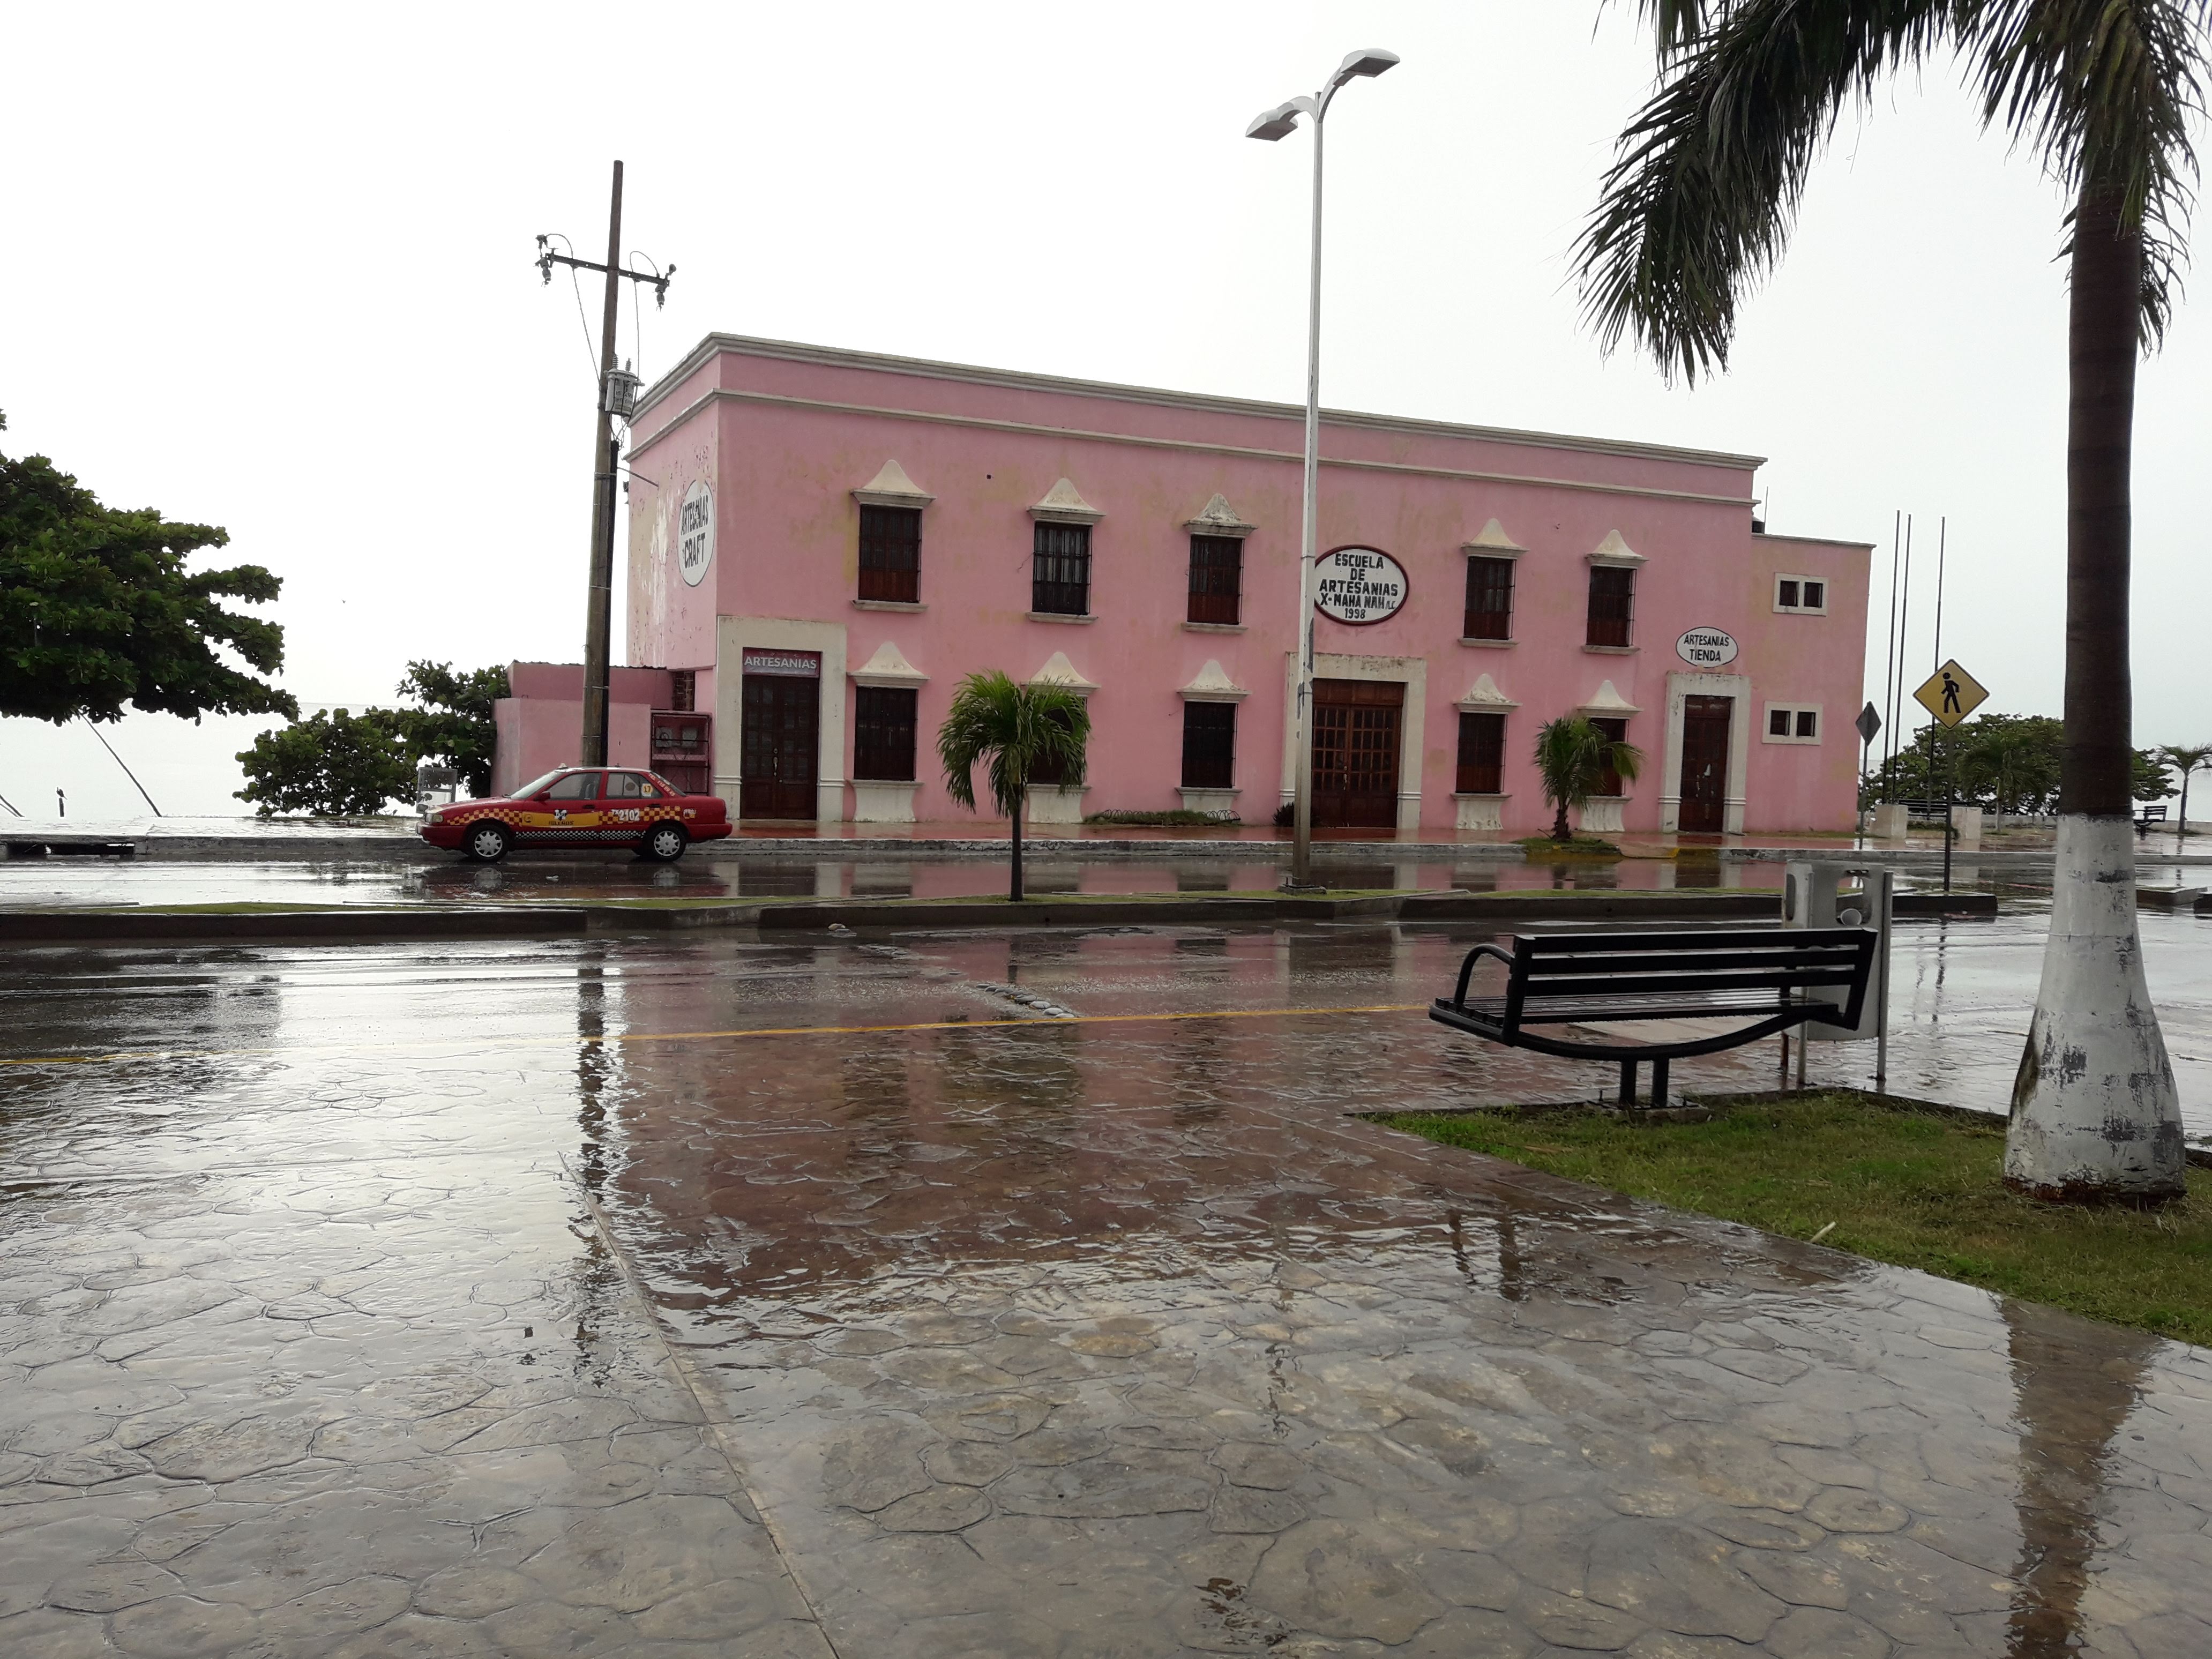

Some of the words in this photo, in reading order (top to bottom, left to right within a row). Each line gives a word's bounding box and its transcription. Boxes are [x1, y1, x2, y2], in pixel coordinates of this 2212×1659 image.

[684, 533, 706, 569] CRAFT
[1335, 553, 1384, 570] ESCUELA
[1350, 568, 1365, 581] DE
[1319, 579, 1399, 596] ARTESANIAS
[1364, 595, 1385, 609] NAH
[1344, 608, 1366, 619] 1998
[1683, 634, 1730, 647] ARTESANIAS
[1689, 648, 1721, 662] TIENDA
[744, 656, 817, 669] ARTESANIAS
[618, 809, 640, 821] 2102
